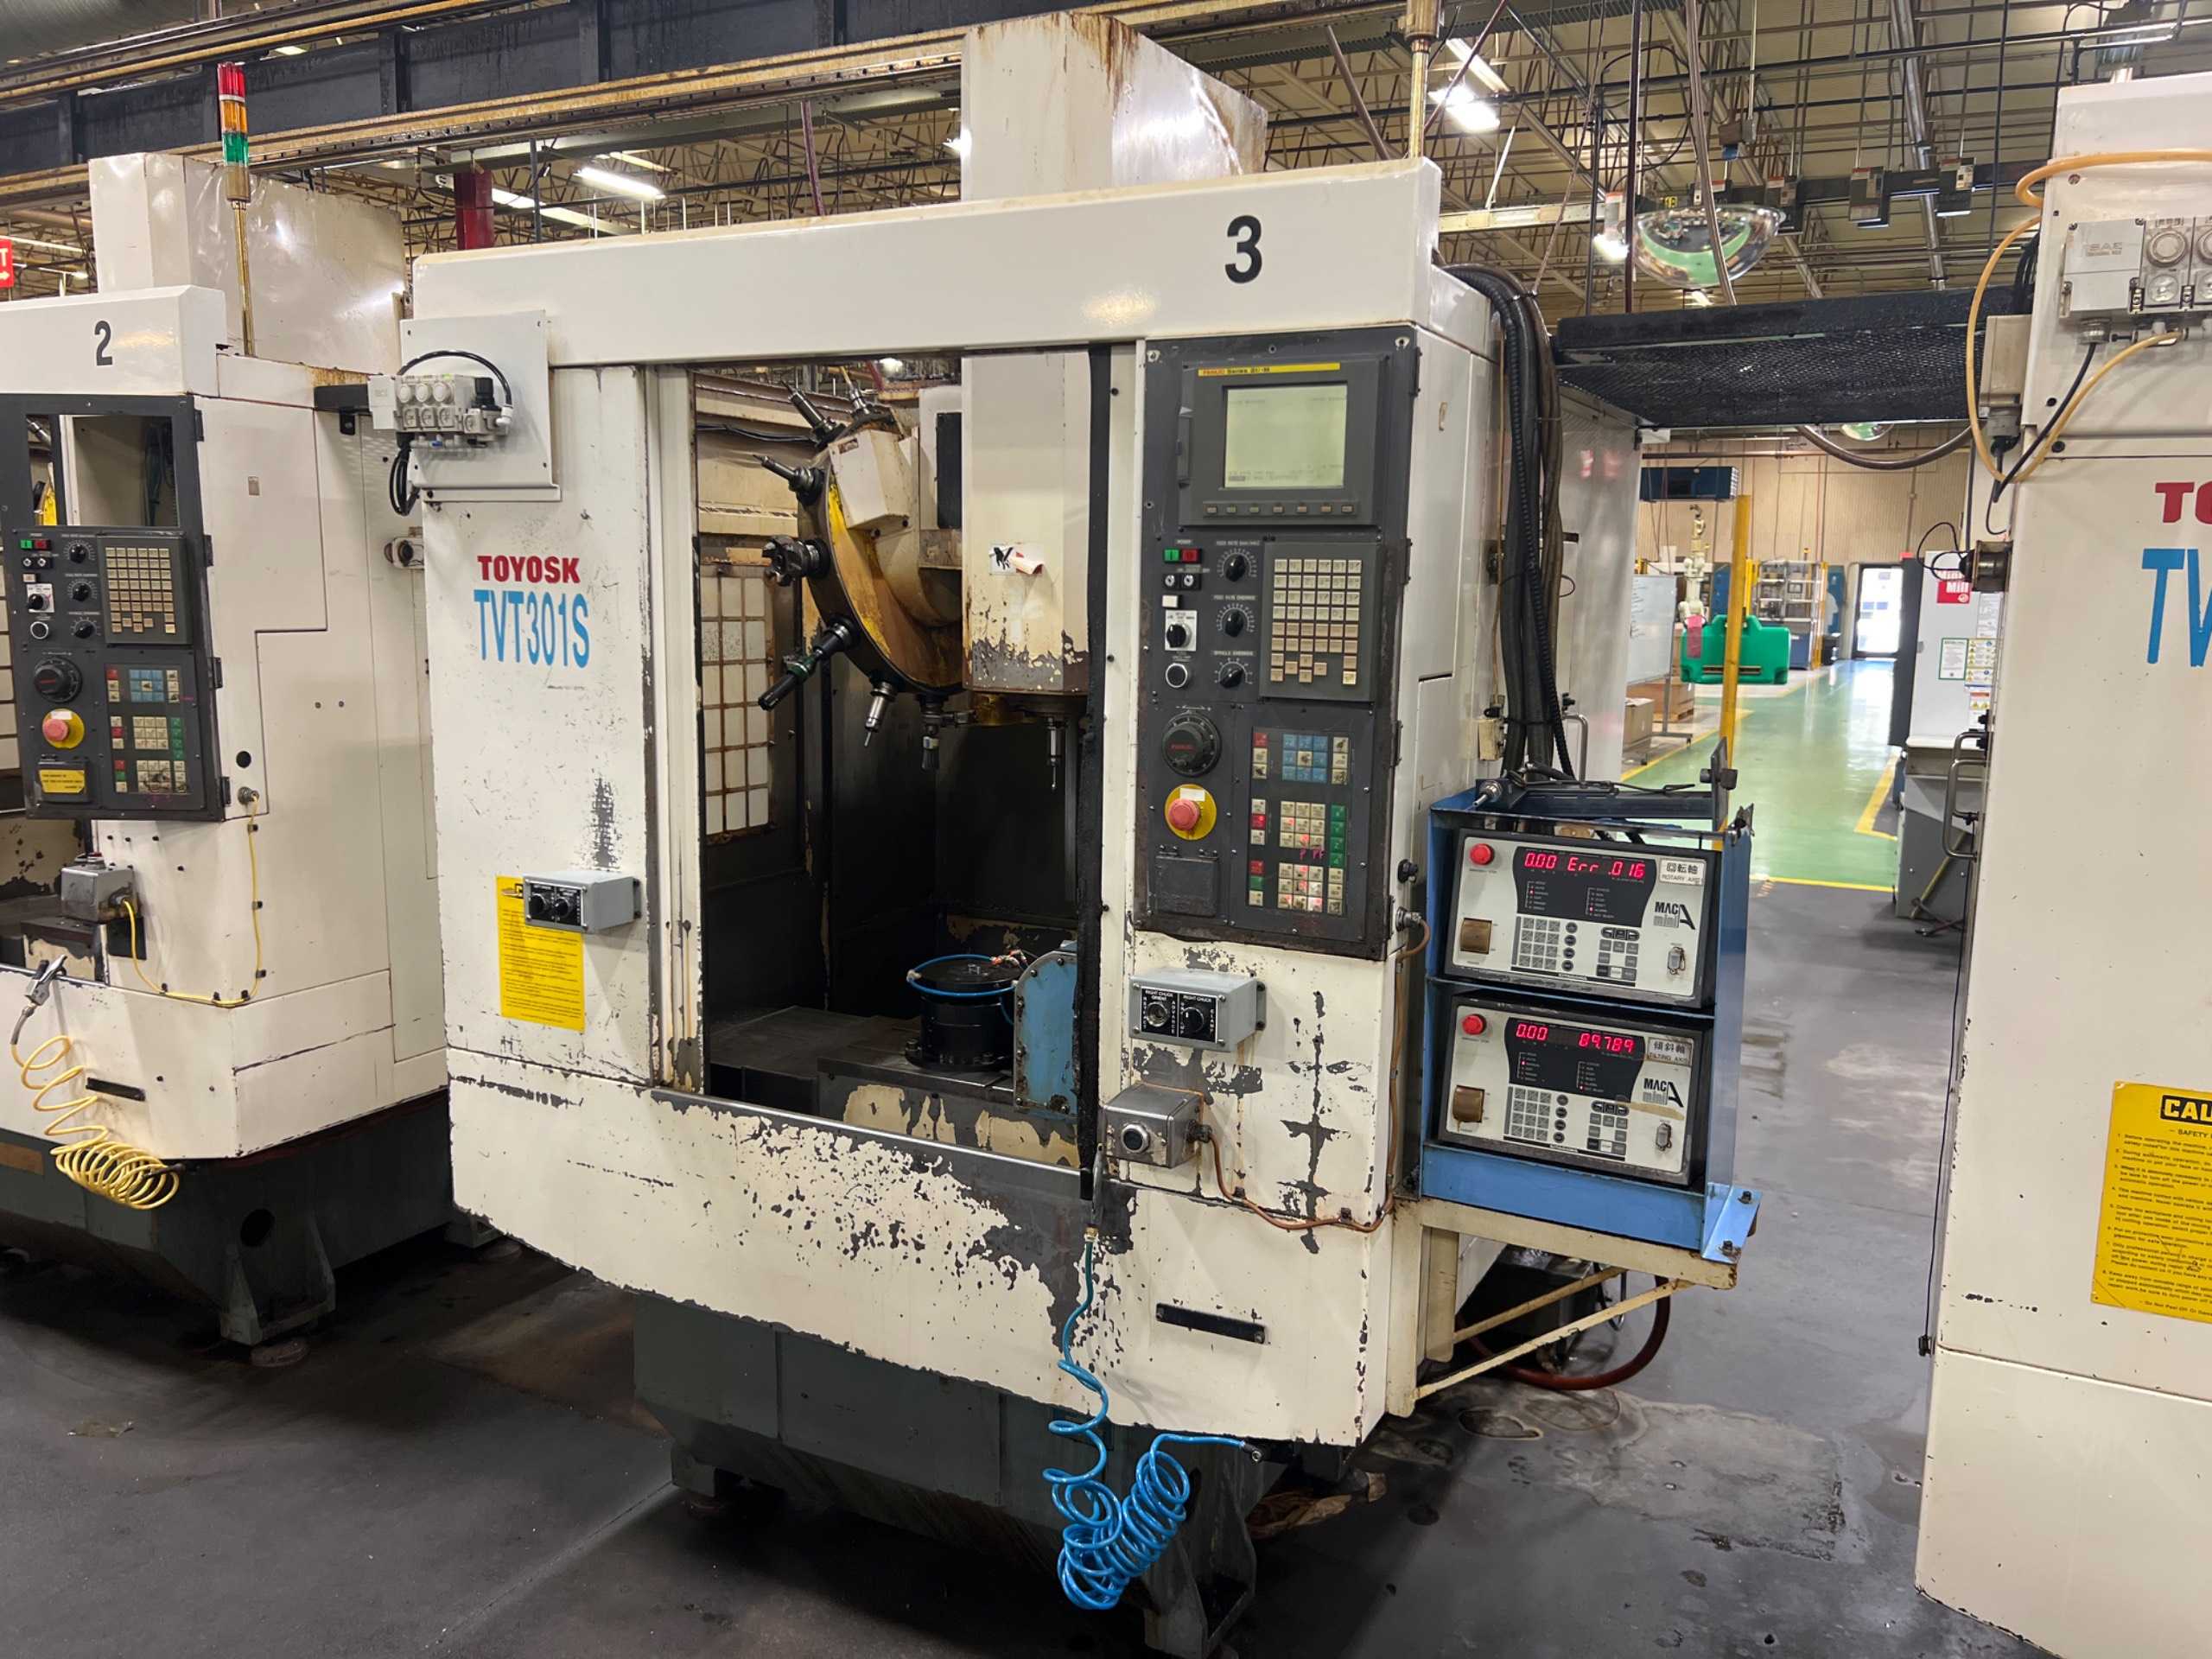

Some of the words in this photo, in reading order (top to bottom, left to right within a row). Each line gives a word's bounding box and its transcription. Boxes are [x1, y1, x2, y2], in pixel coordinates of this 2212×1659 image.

[1224, 214, 1262, 283] 3
[94, 321, 113, 365] 2
[477, 556, 581, 583] TOYOSK
[474, 589, 590, 669] TVT301S
[1524, 853, 1558, 869] 0.00
[1567, 857, 1599, 872] Err
[1655, 901, 1679, 915] MAC
[1516, 1023, 1548, 1040] 0.00
[1643, 1078, 1667, 1091] MAC
[2164, 1099, 2212, 1122] CAU
